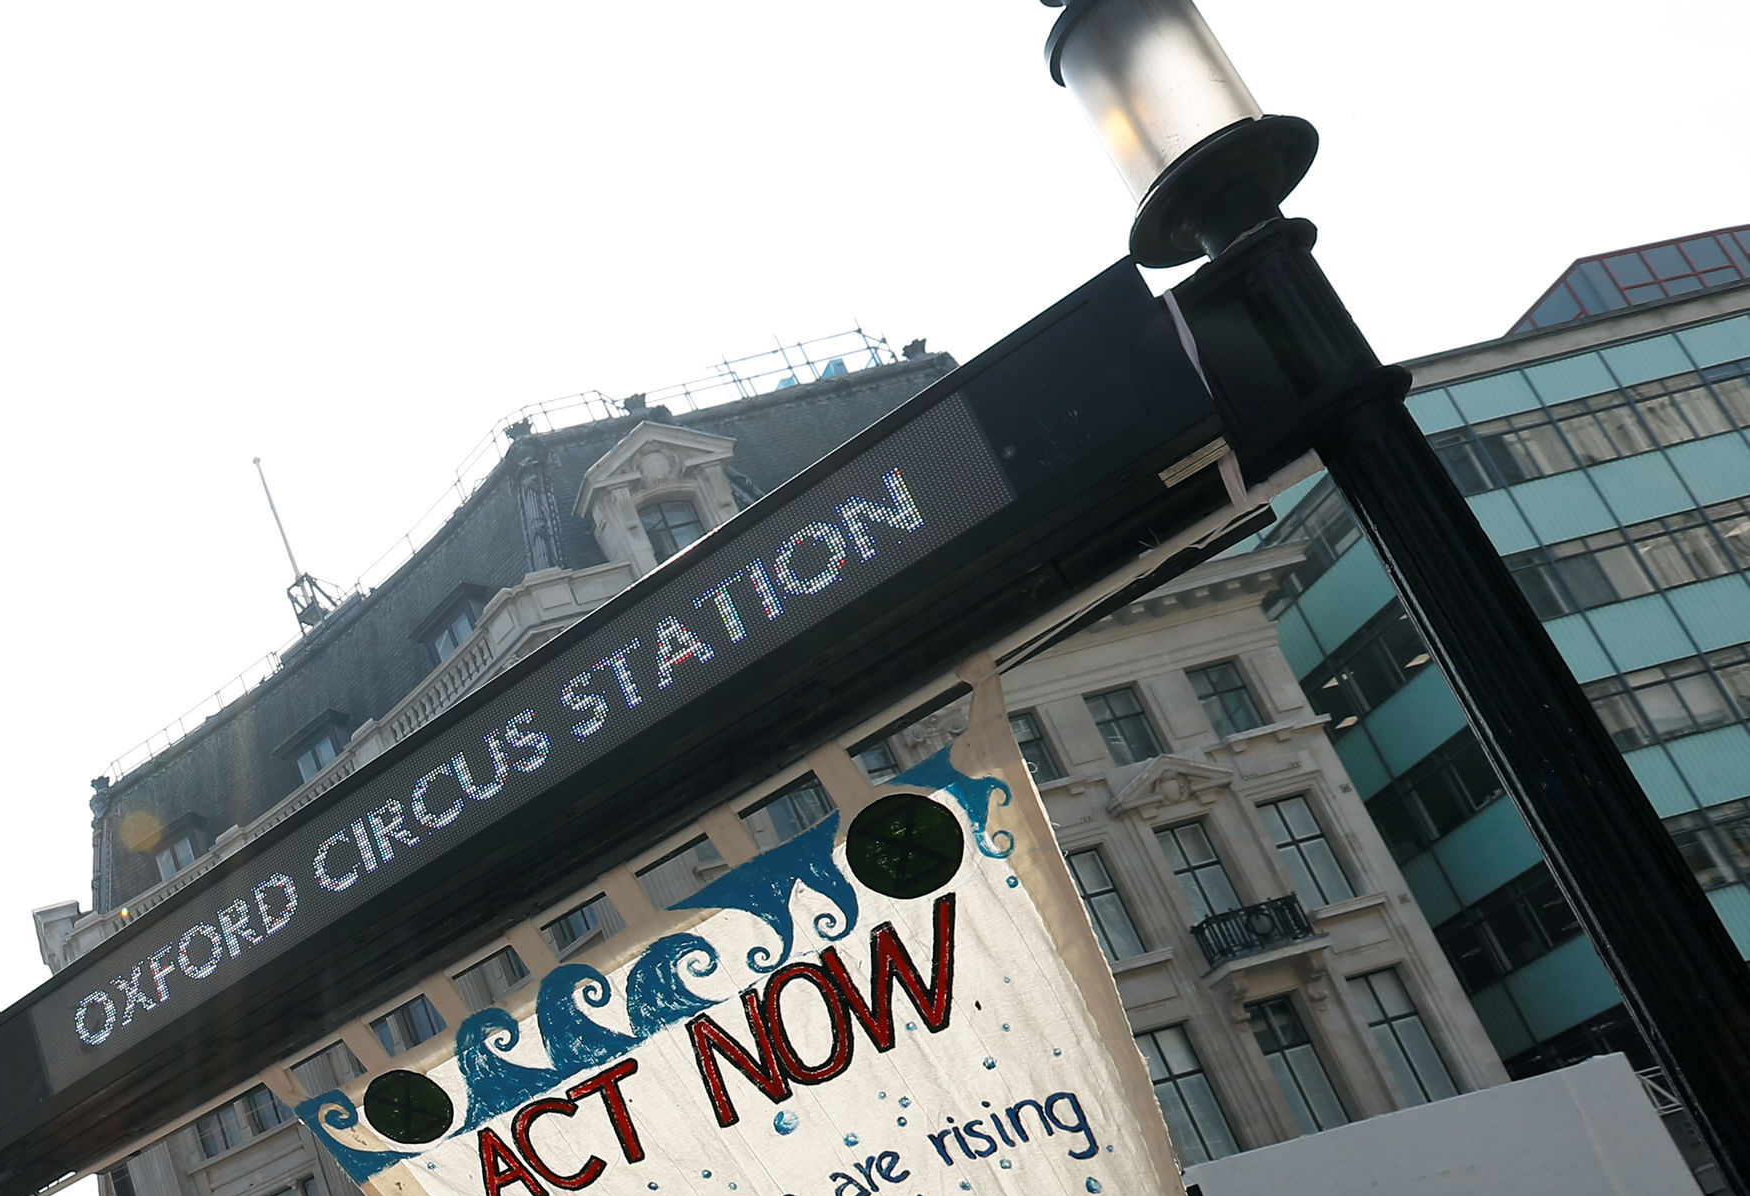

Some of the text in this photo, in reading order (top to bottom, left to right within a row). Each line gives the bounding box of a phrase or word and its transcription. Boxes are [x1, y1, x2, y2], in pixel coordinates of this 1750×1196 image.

[75, 467, 924, 1045] OXFORD CIRCUS STATION
[686, 893, 956, 1128] NOW
[929, 1091, 1101, 1167] rising
